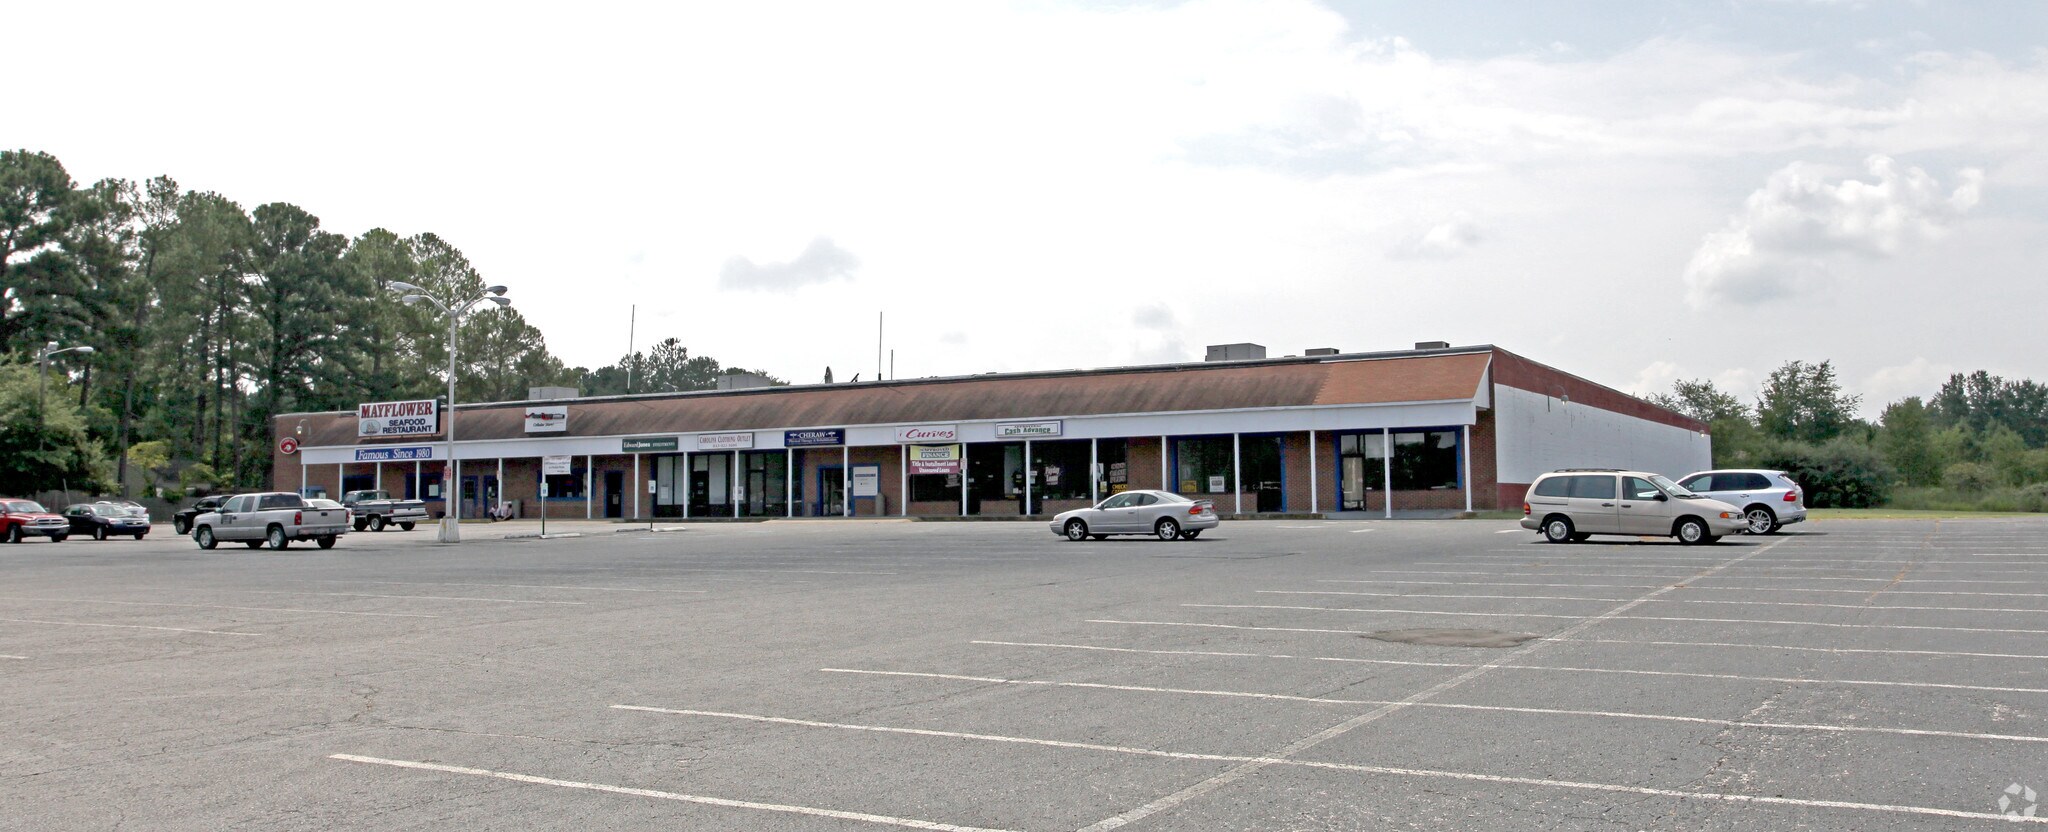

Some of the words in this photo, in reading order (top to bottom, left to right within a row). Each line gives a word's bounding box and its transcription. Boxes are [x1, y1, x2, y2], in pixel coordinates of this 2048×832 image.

[361, 401, 433, 418] MAYFLOWER
[389, 418, 426, 427] SEAFOOD
[382, 425, 433, 434] RESTAURANT
[906, 429, 954, 439] Curves
[1004, 427, 1021, 436] Cash
[799, 431, 826, 439] CHERAW
[358, 450, 389, 460] Famous
[393, 448, 413, 459] Since
[416, 448, 430, 458] 1980
